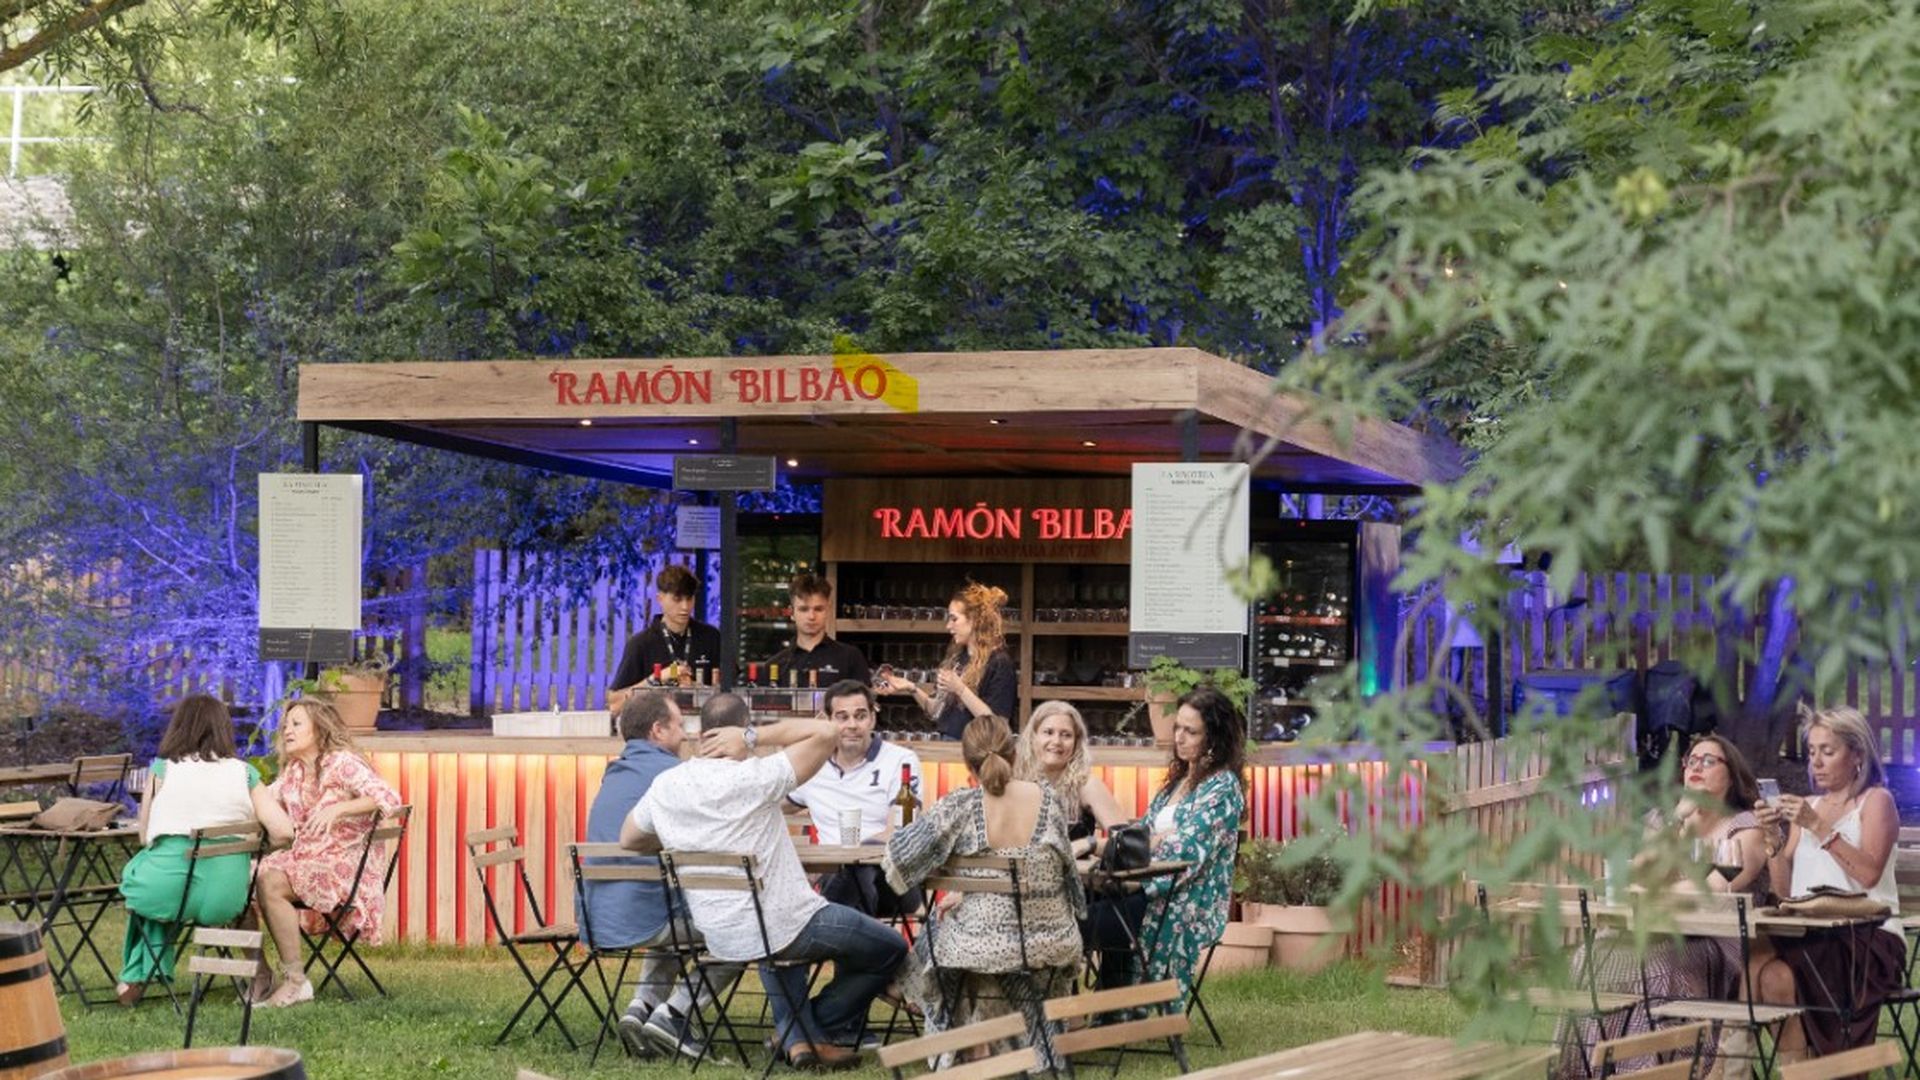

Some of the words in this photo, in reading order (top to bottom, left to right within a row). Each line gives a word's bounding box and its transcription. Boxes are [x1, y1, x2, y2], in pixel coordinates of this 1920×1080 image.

[550, 365, 712, 404] RAMÓN
[730, 364, 888, 404] BILBAO
[873, 502, 1022, 539] RAMÓN
[1031, 507, 1134, 540] BILBA
[869, 769, 880, 786] 1
